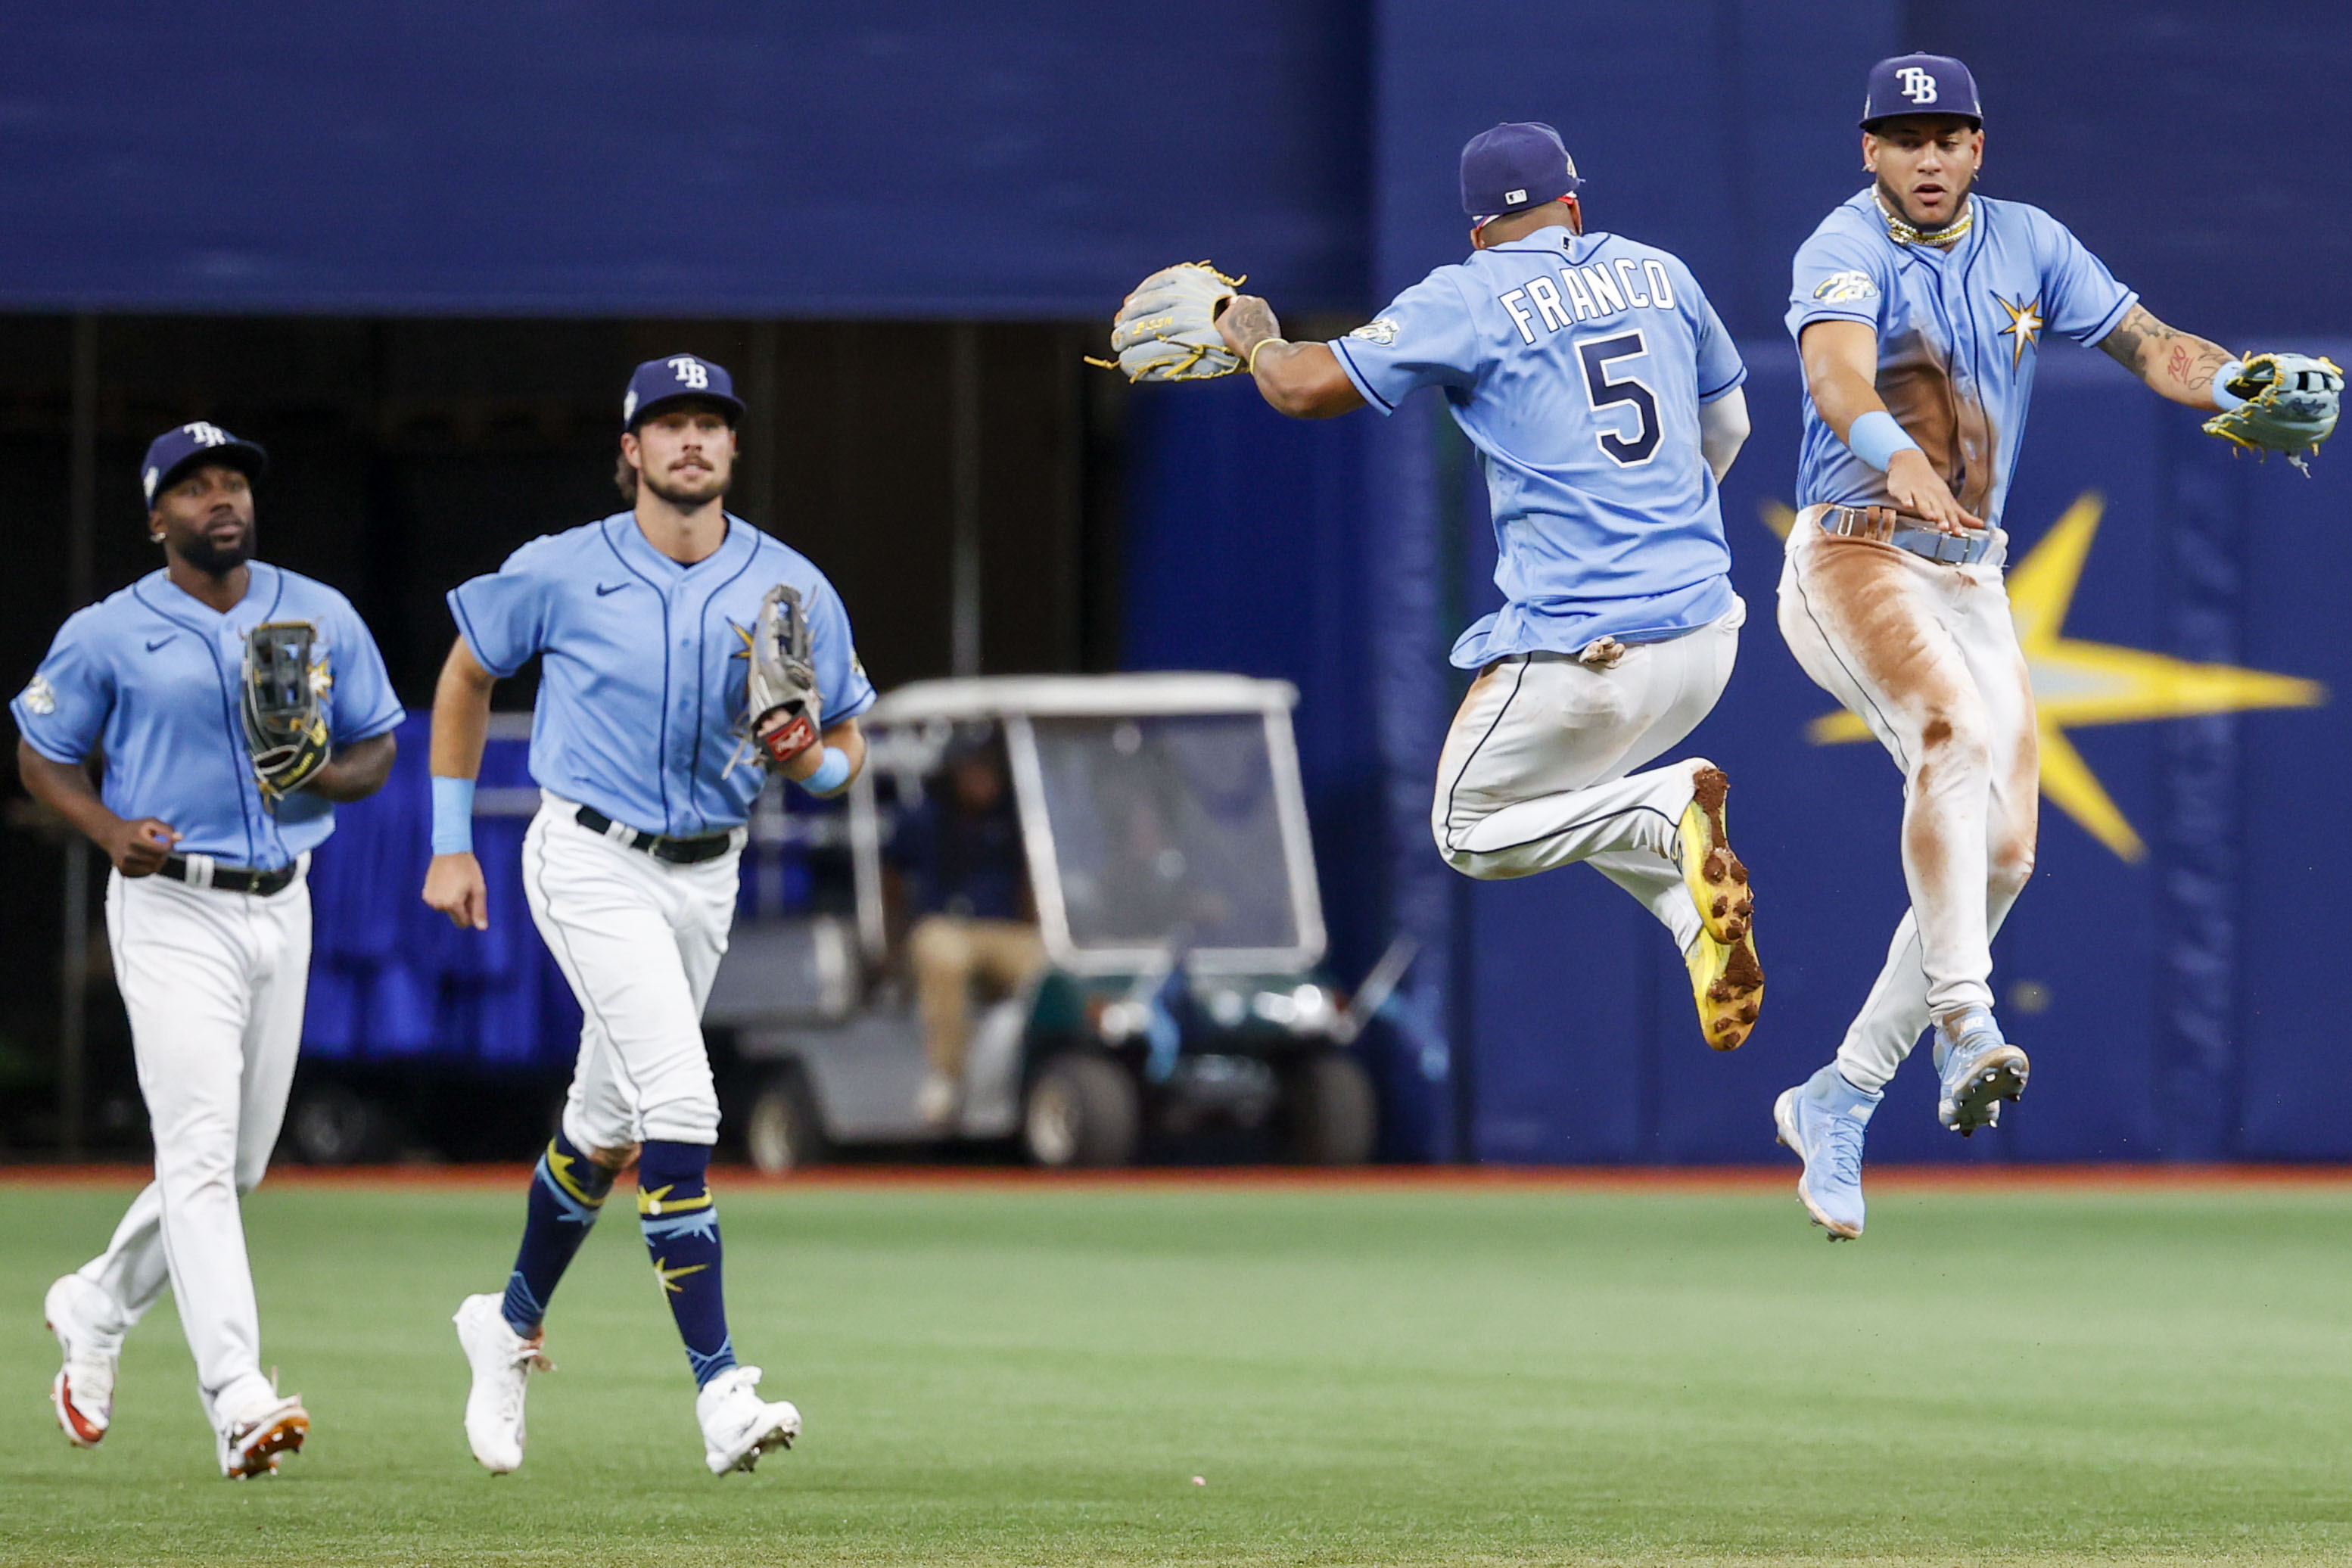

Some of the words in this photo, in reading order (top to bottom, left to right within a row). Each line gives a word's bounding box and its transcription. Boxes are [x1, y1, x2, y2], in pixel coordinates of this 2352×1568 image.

[1895, 67, 1938, 104] TB
[1498, 258, 1675, 345] FRANCO
[667, 357, 708, 389] TB
[2167, 345, 2187, 381] 100
[1573, 328, 1666, 468] 5
